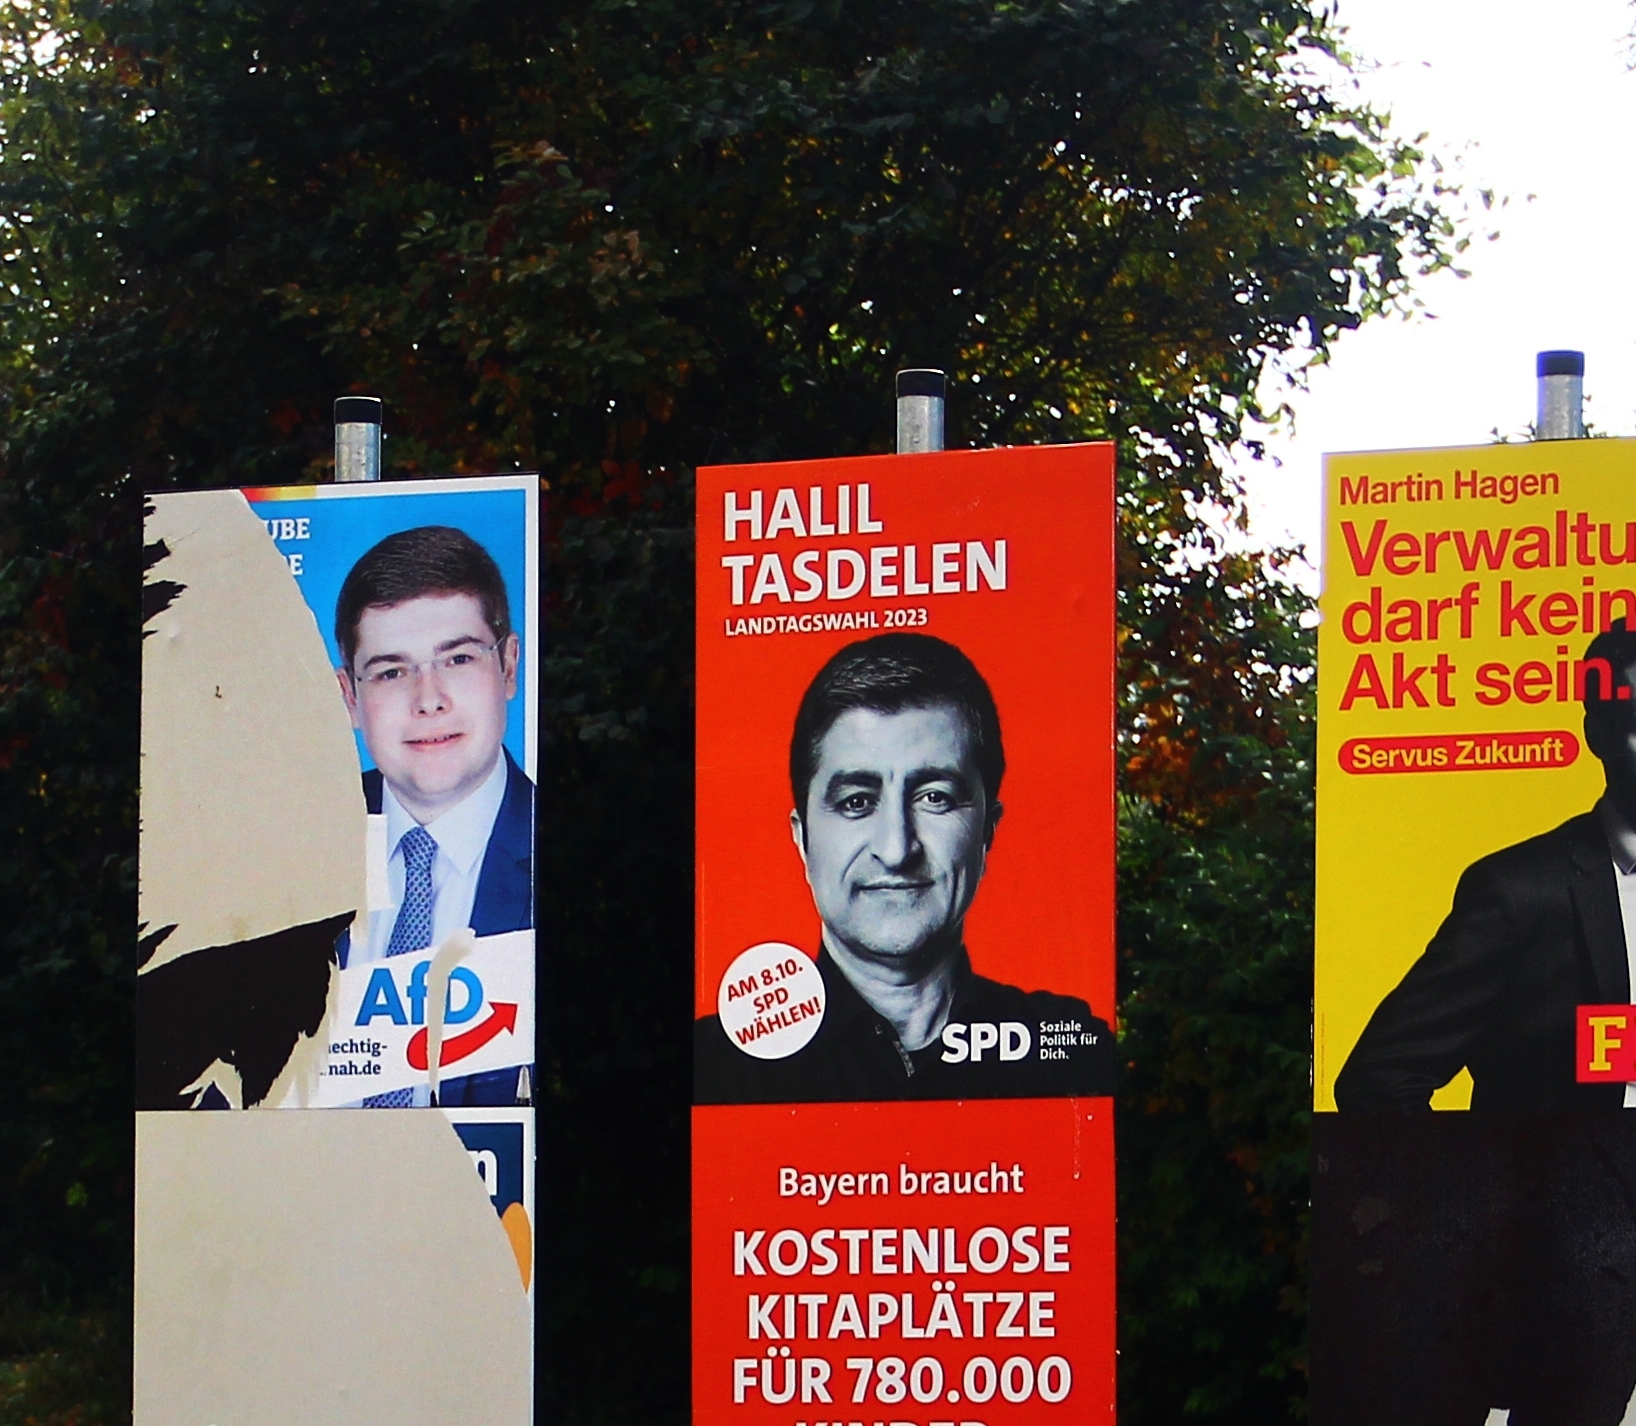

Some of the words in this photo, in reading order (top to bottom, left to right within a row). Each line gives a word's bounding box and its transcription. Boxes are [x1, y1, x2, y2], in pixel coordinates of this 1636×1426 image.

[1340, 474, 1443, 505] Martin
[1455, 472, 1560, 504] Hagen
[724, 483, 883, 542] HALIL
[722, 540, 1008, 605] TASDELEN
[725, 613, 879, 636] LANDTAGSWAHL
[884, 609, 928, 628] 2023
[1341, 581, 1479, 644] darf
[1339, 653, 1455, 711] Akt
[1476, 645, 1631, 705] sein.
[1352, 741, 1449, 769] Servus
[1456, 737, 1564, 765] Zukunft
[355, 960, 484, 1027] AfD
[727, 978, 758, 1003] AM
[760, 959, 804, 987] 8.10.
[753, 988, 789, 1014] SPD
[736, 999, 822, 1046] WÄHLEN!
[941, 1022, 1031, 1063] SPD
[1040, 1033, 1077, 1047] Politik
[1080, 1032, 1098, 1045] für
[780, 1166, 889, 1204] Bayern
[900, 1162, 1025, 1196] braucht
[734, 1227, 1071, 1276] KOSTENLOSE
[749, 1280, 1056, 1339] KITAPLÄTZE
[734, 1345, 832, 1404] FÜR
[847, 1356, 1072, 1404] 780.000
